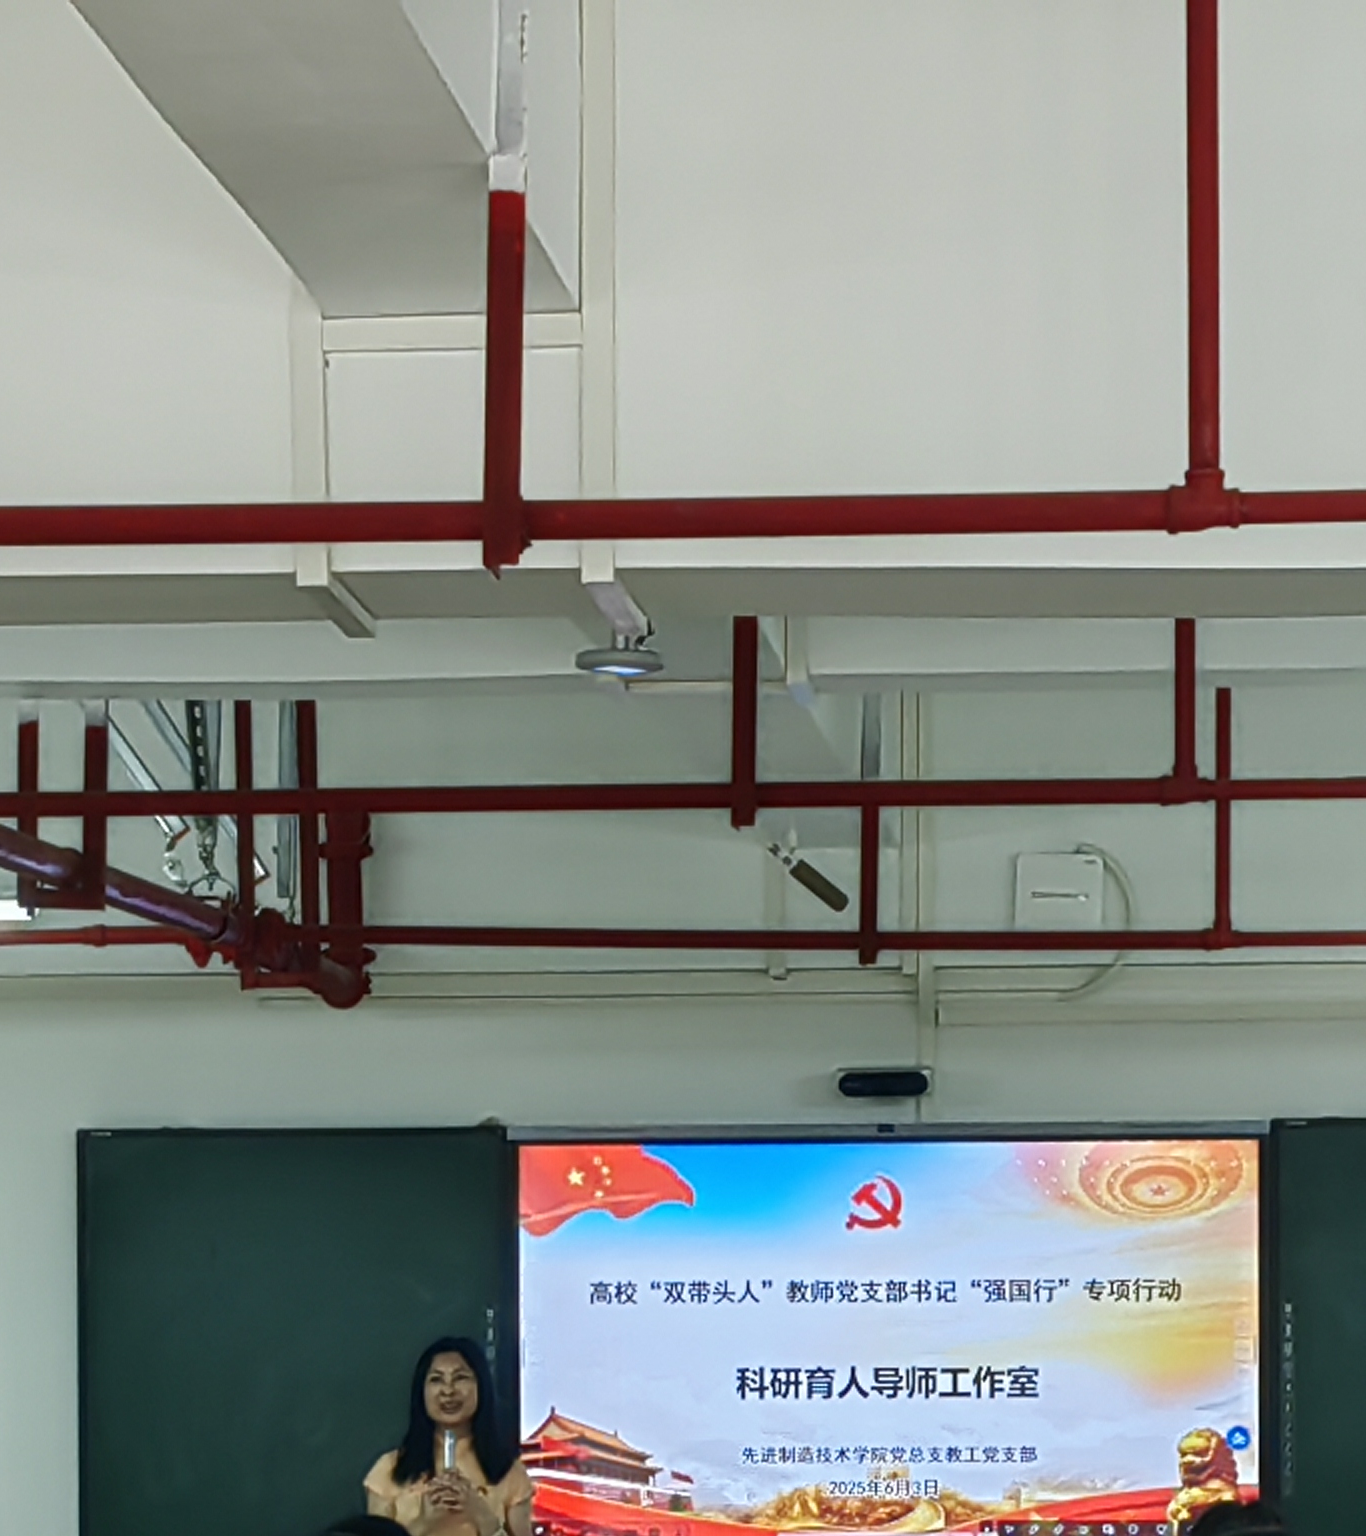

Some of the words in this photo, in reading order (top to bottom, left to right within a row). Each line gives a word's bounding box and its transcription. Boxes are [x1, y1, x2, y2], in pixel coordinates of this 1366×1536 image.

[736, 1365, 1039, 1400] 科研育人导师工作室
[741, 1445, 1039, 1464] 先进制造技术学院党总支教工党支部
[828, 1478, 939, 1497] 2025年6月3日
